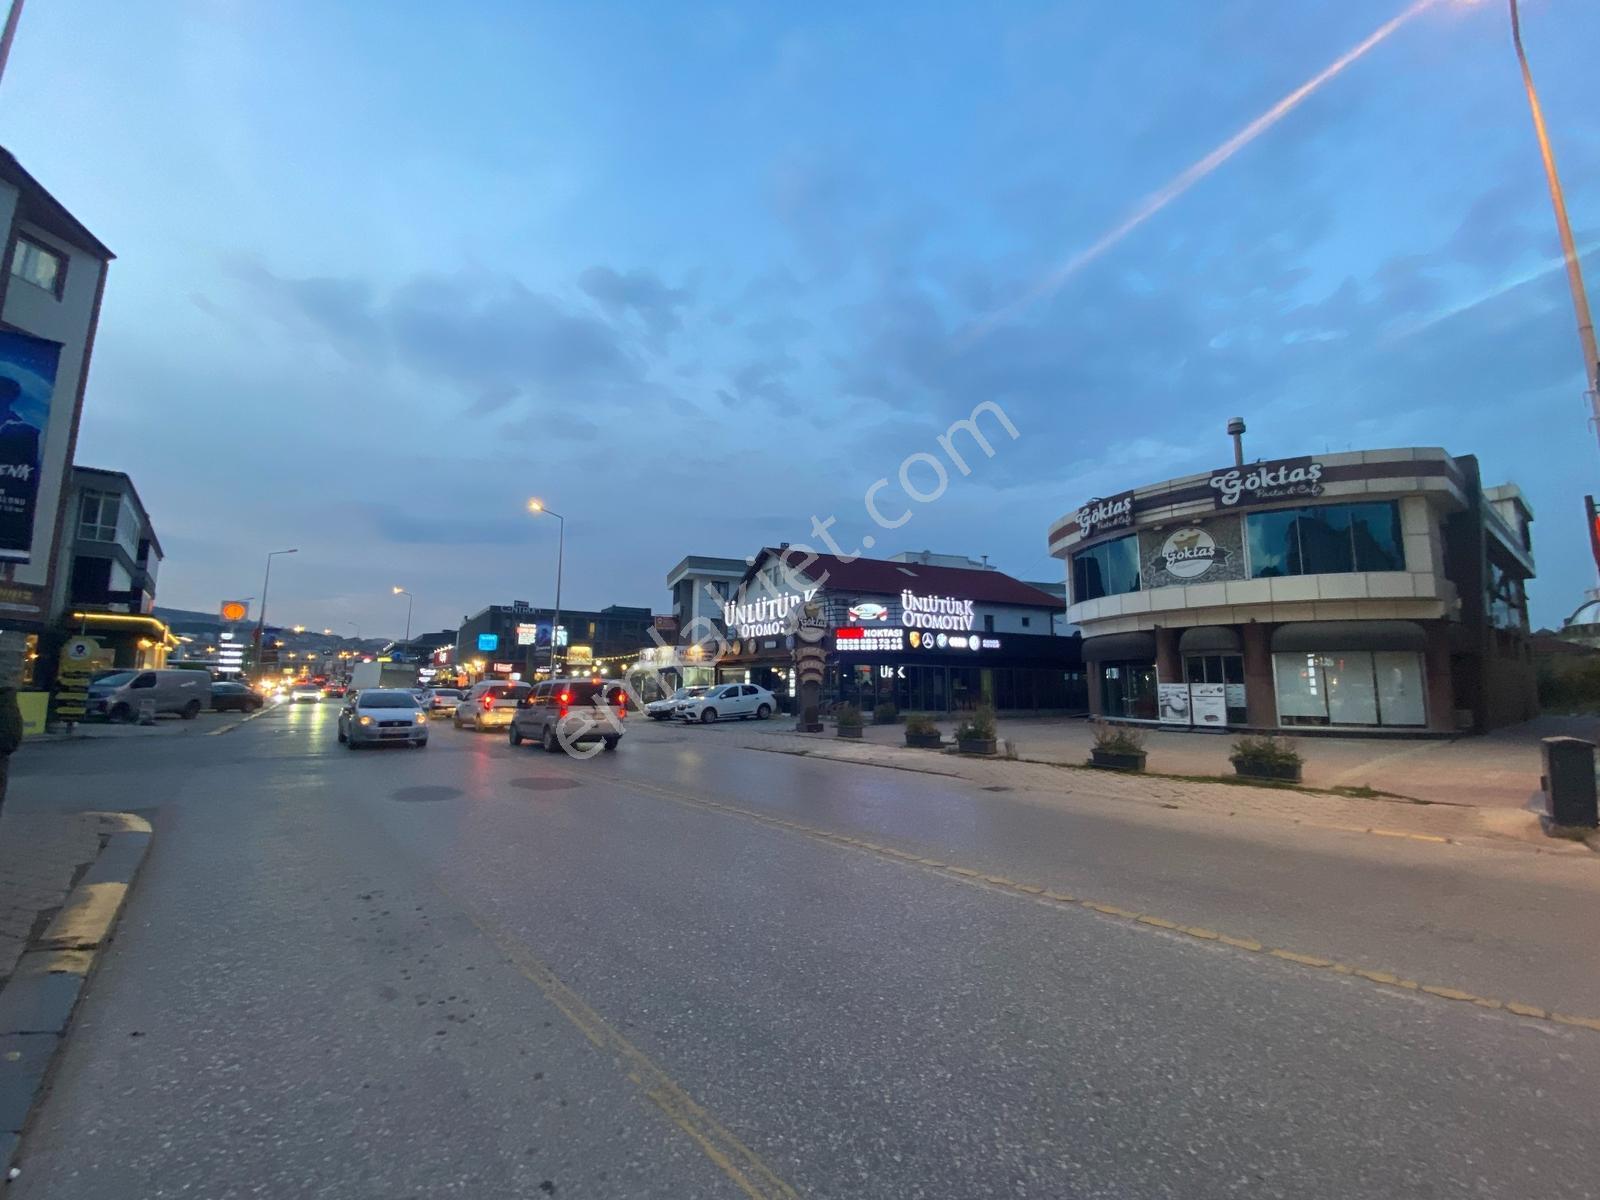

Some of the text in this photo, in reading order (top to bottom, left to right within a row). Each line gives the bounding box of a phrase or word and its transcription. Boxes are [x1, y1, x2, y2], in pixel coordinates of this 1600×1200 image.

[1210, 463, 1325, 505] Göktaş
[1075, 497, 1132, 537] Göktaş
[901, 589, 975, 616] ÜNLÜTÜRK
[902, 610, 974, 631] OTOMOTİV
